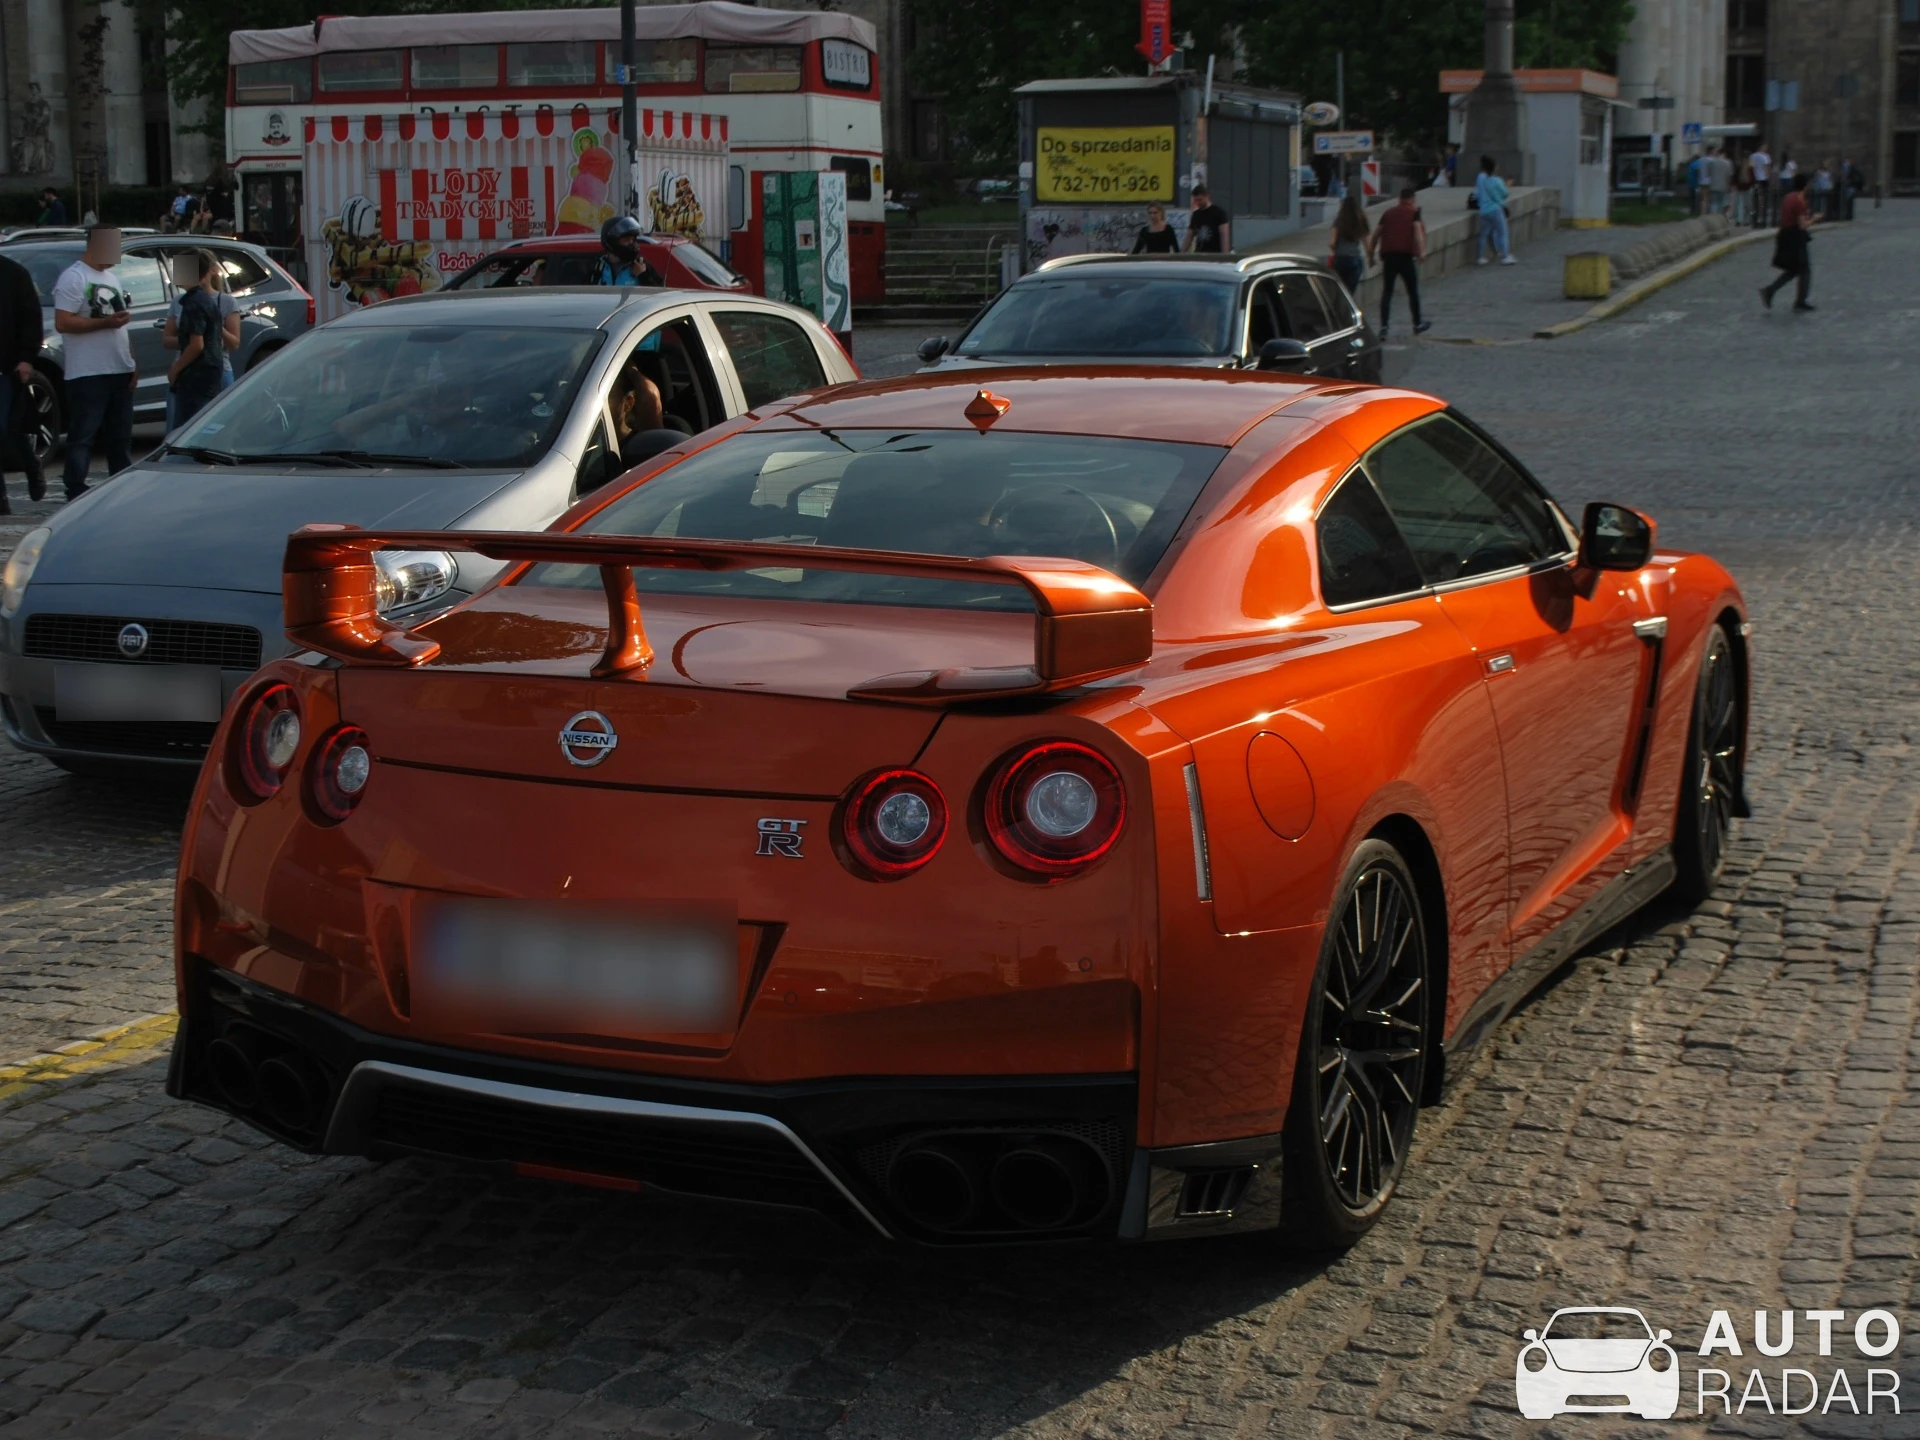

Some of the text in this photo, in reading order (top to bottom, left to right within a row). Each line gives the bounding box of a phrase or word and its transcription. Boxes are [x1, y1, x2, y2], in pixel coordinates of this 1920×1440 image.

[827, 50, 866, 74] BISTRO
[1041, 135, 1171, 157] Do sprzedania
[430, 171, 502, 195] LODY
[1052, 175, 1160, 192] 732-701-926
[396, 199, 535, 221] TRADYCYJNE
[562, 733, 610, 745] NISSAN
[757, 818, 808, 832] GT
[755, 831, 804, 857] R
